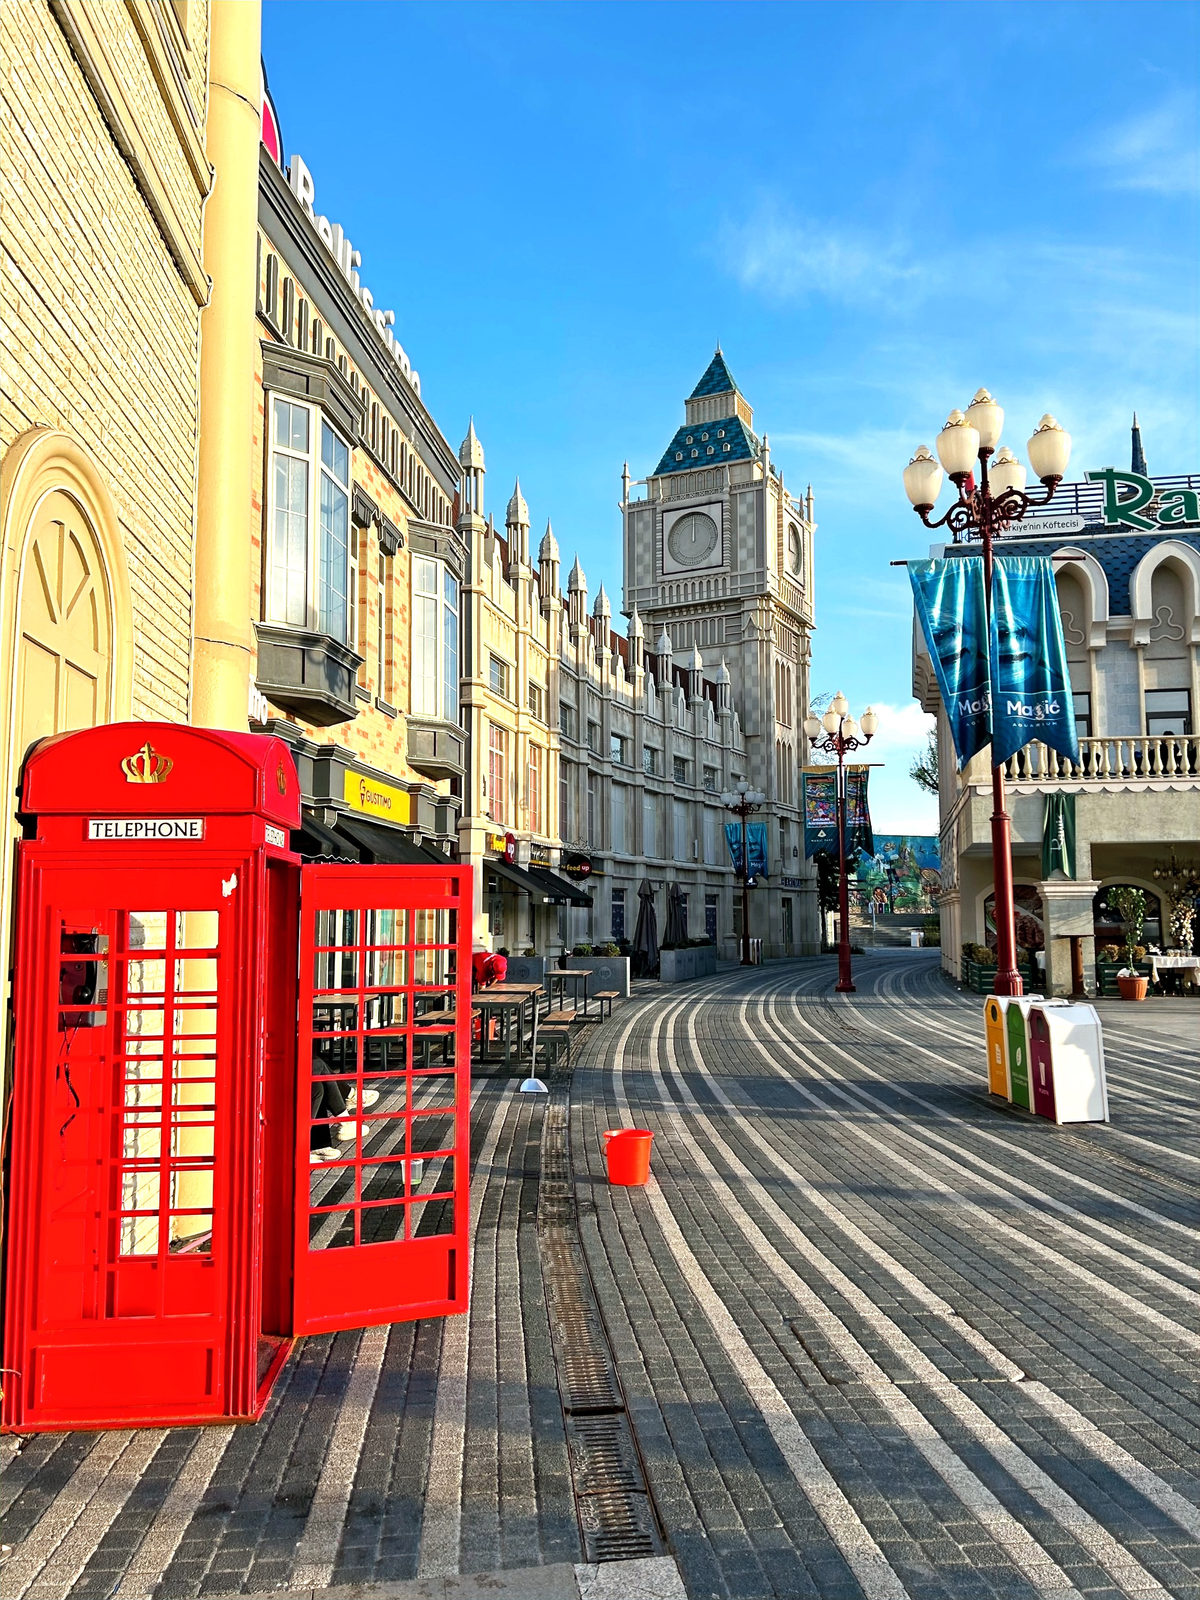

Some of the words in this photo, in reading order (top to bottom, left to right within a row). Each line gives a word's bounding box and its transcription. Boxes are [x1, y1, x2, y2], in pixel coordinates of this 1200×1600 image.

[1084, 466, 1200, 531] Ra
[1000, 522, 1041, 533] rkiye'nin
[1007, 699, 1060, 720] Magic
[92, 822, 199, 838] TELEPHONE
